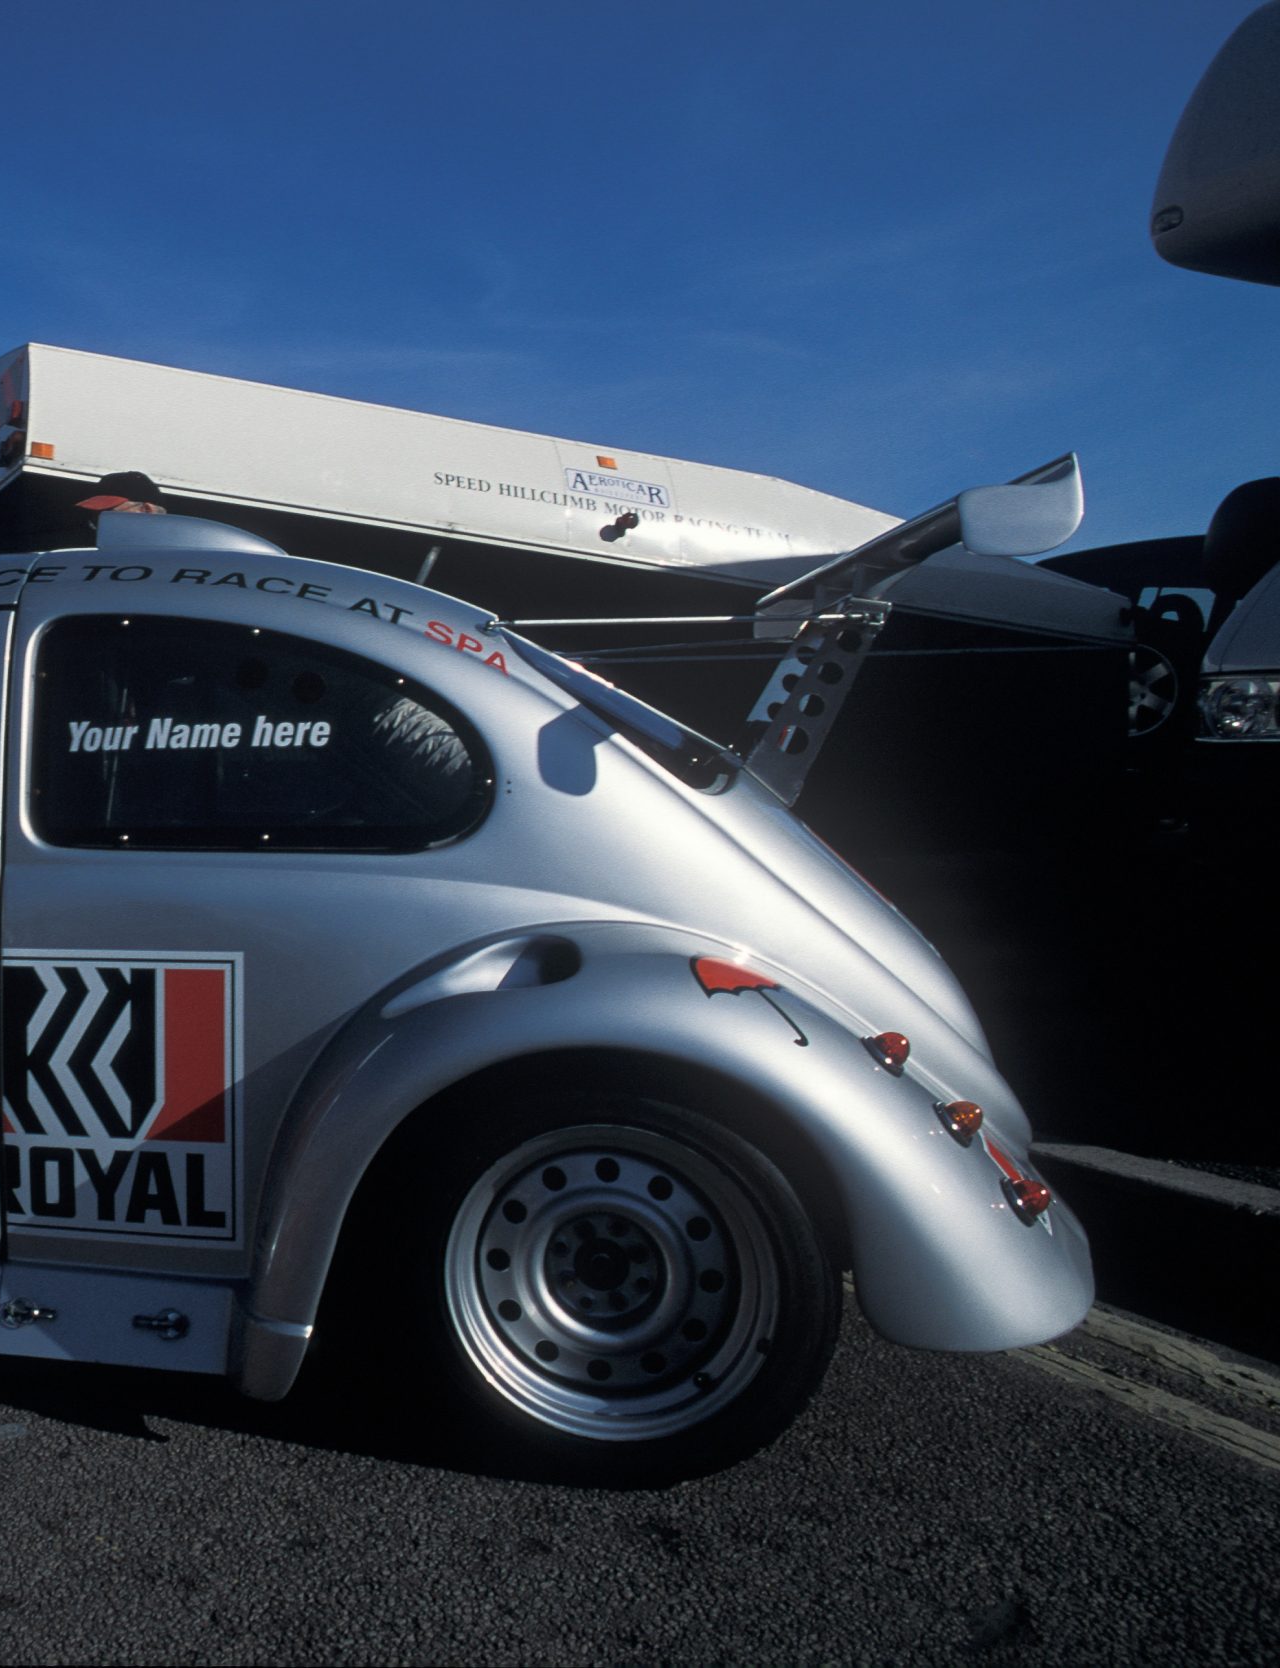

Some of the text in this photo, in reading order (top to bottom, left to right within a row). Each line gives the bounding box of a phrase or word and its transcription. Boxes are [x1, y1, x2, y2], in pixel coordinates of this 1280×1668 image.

[433, 471, 491, 493] SPEED
[498, 483, 597, 512] HILLCLIMB
[743, 526, 791, 545] TEM
[82, 565, 153, 582] TO
[169, 568, 333, 604] RACE
[348, 596, 415, 626] AT
[423, 619, 511, 677] SPA
[68, 714, 331, 753] Your Name here
